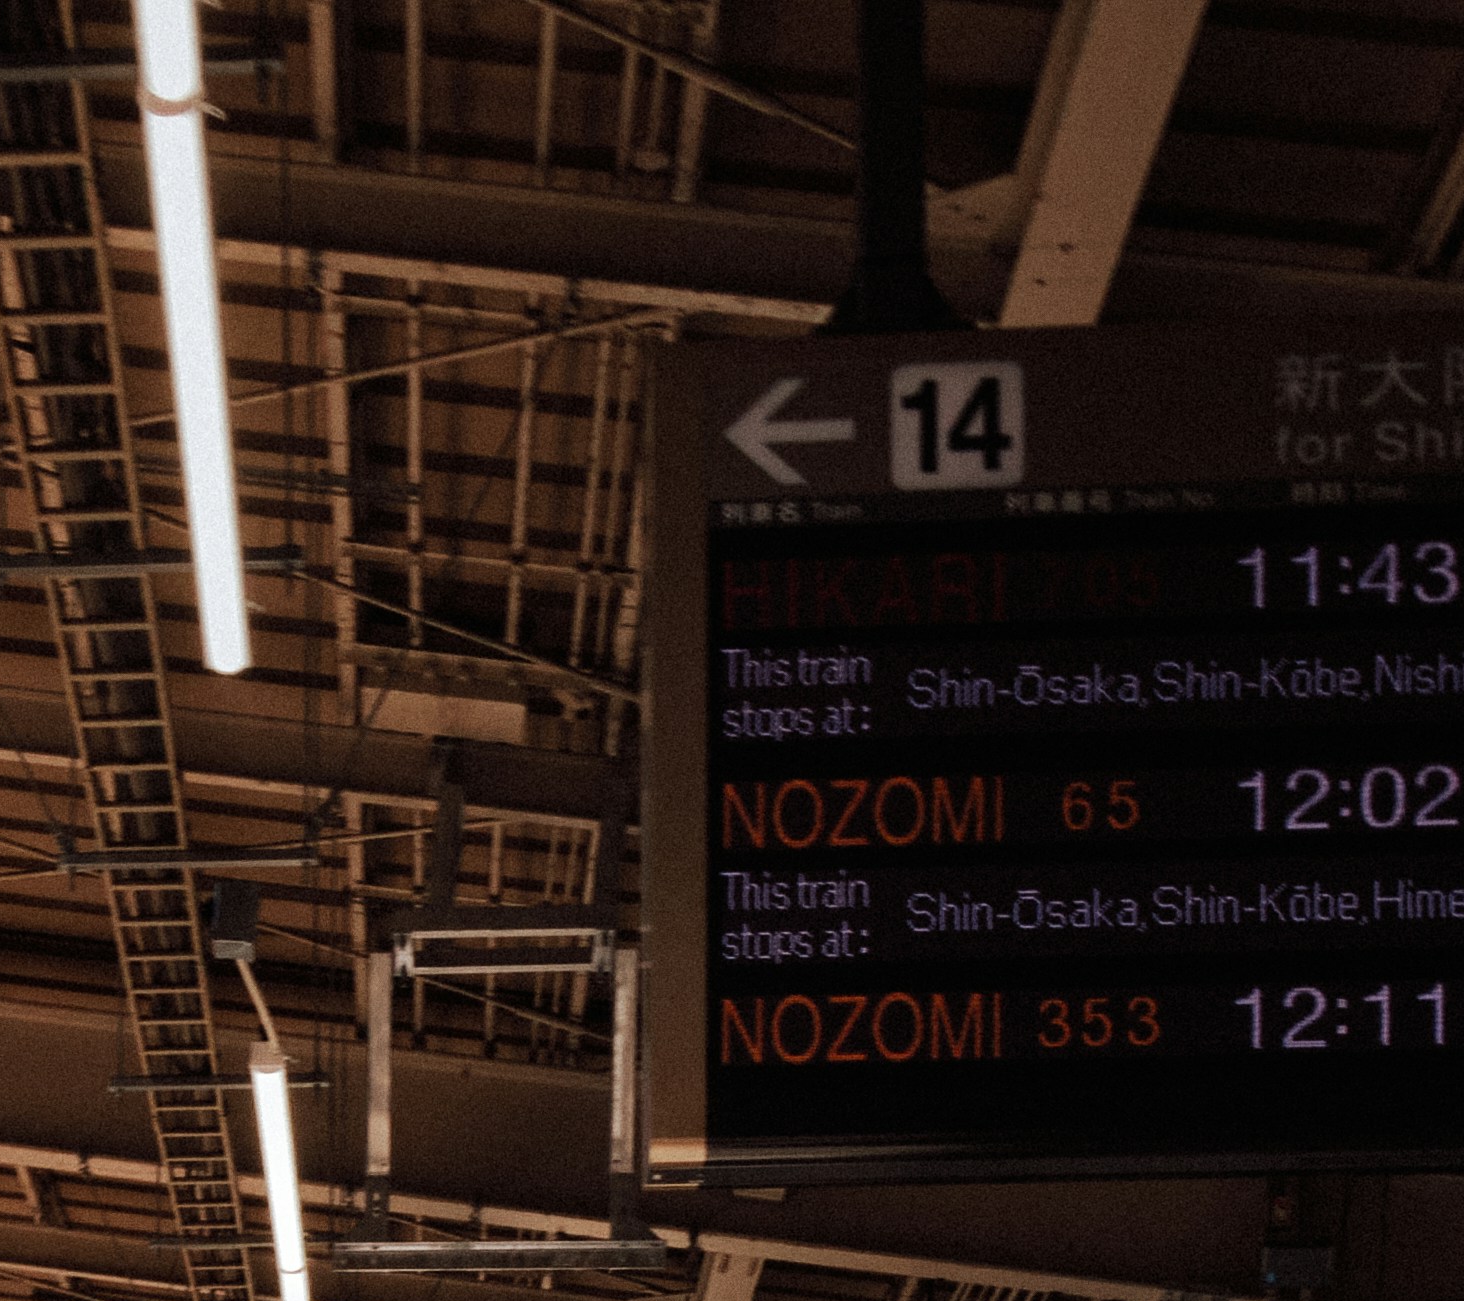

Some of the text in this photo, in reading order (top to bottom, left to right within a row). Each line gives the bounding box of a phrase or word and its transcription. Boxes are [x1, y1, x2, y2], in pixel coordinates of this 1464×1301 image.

[902, 378, 1011, 473] 14
[1275, 424, 1353, 466] for
[722, 553, 1008, 631] HIKARI
[1235, 541, 1462, 610] 11:43
[722, 775, 1007, 851] NOZOMI
[1061, 779, 1142, 833] 65
[1236, 764, 1462, 834] 12:02
[720, 990, 1004, 1066] NOZOMI
[1038, 995, 1162, 1050] 353
[1233, 981, 1446, 1051] 12:11
